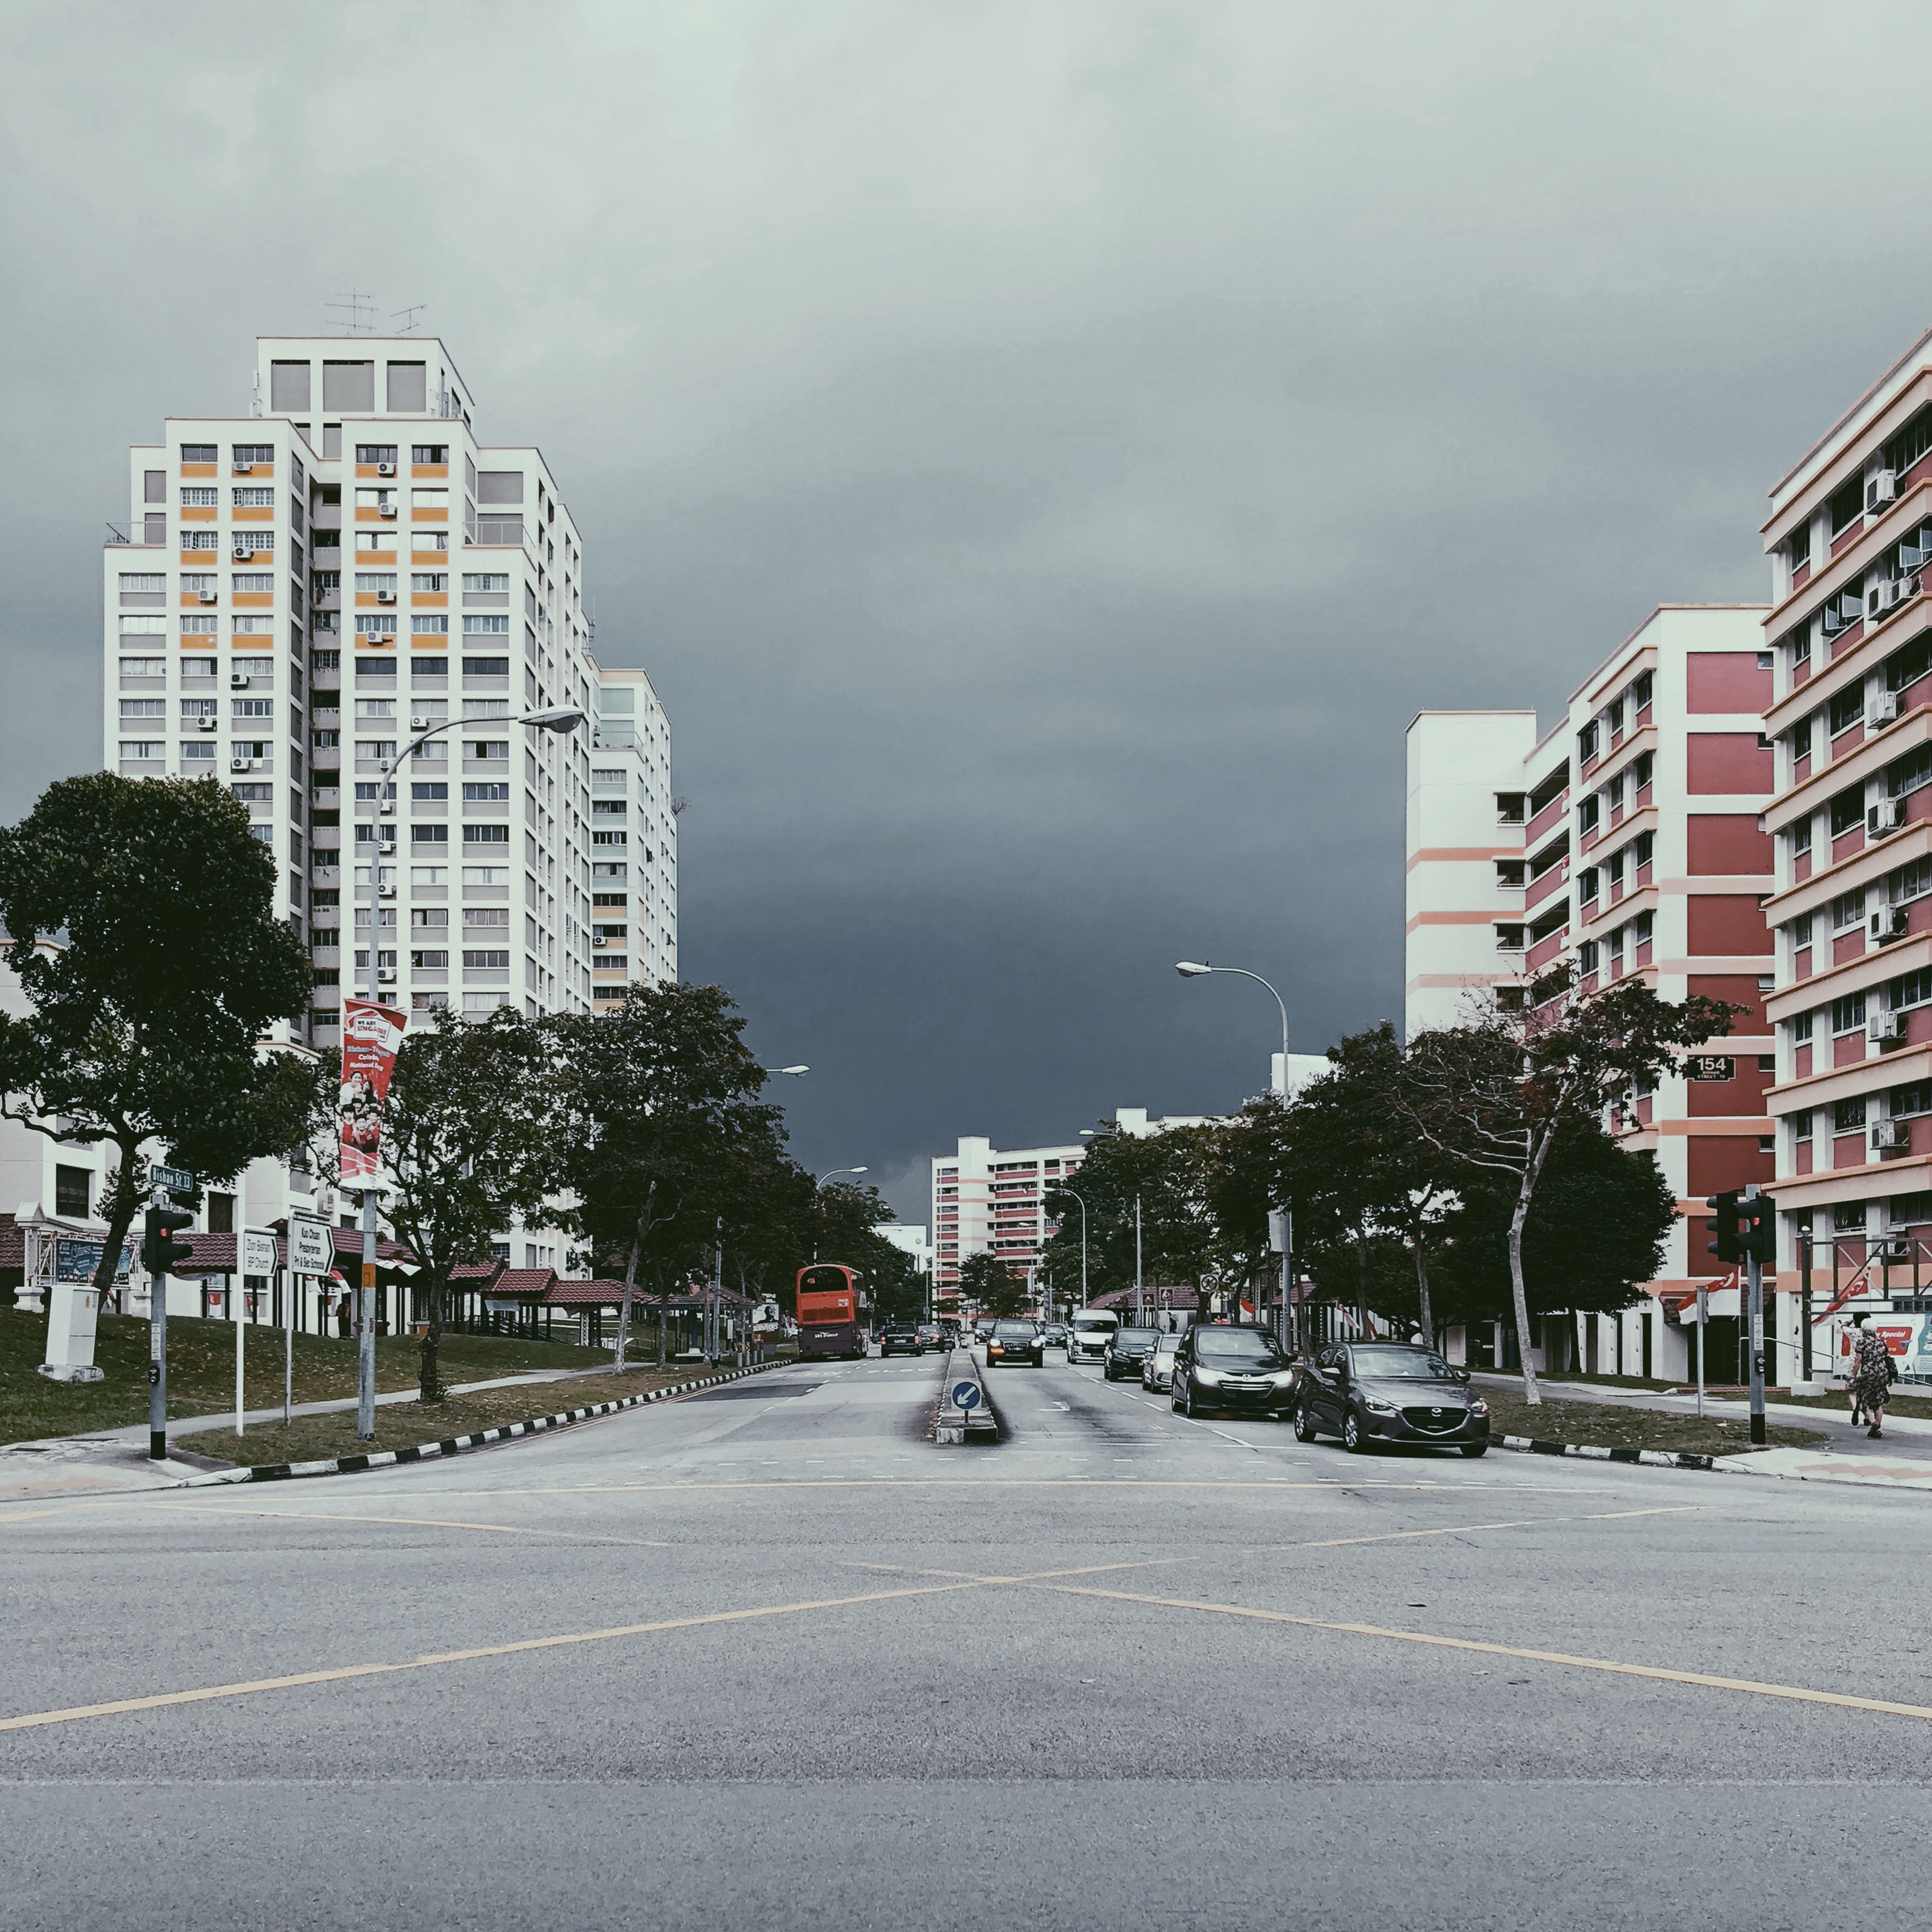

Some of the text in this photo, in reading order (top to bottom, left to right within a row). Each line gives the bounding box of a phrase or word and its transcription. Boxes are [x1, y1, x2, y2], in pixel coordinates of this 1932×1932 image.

[1697, 1057, 1726, 1070] 154
[153, 1167, 190, 1188] Bishan St 13
